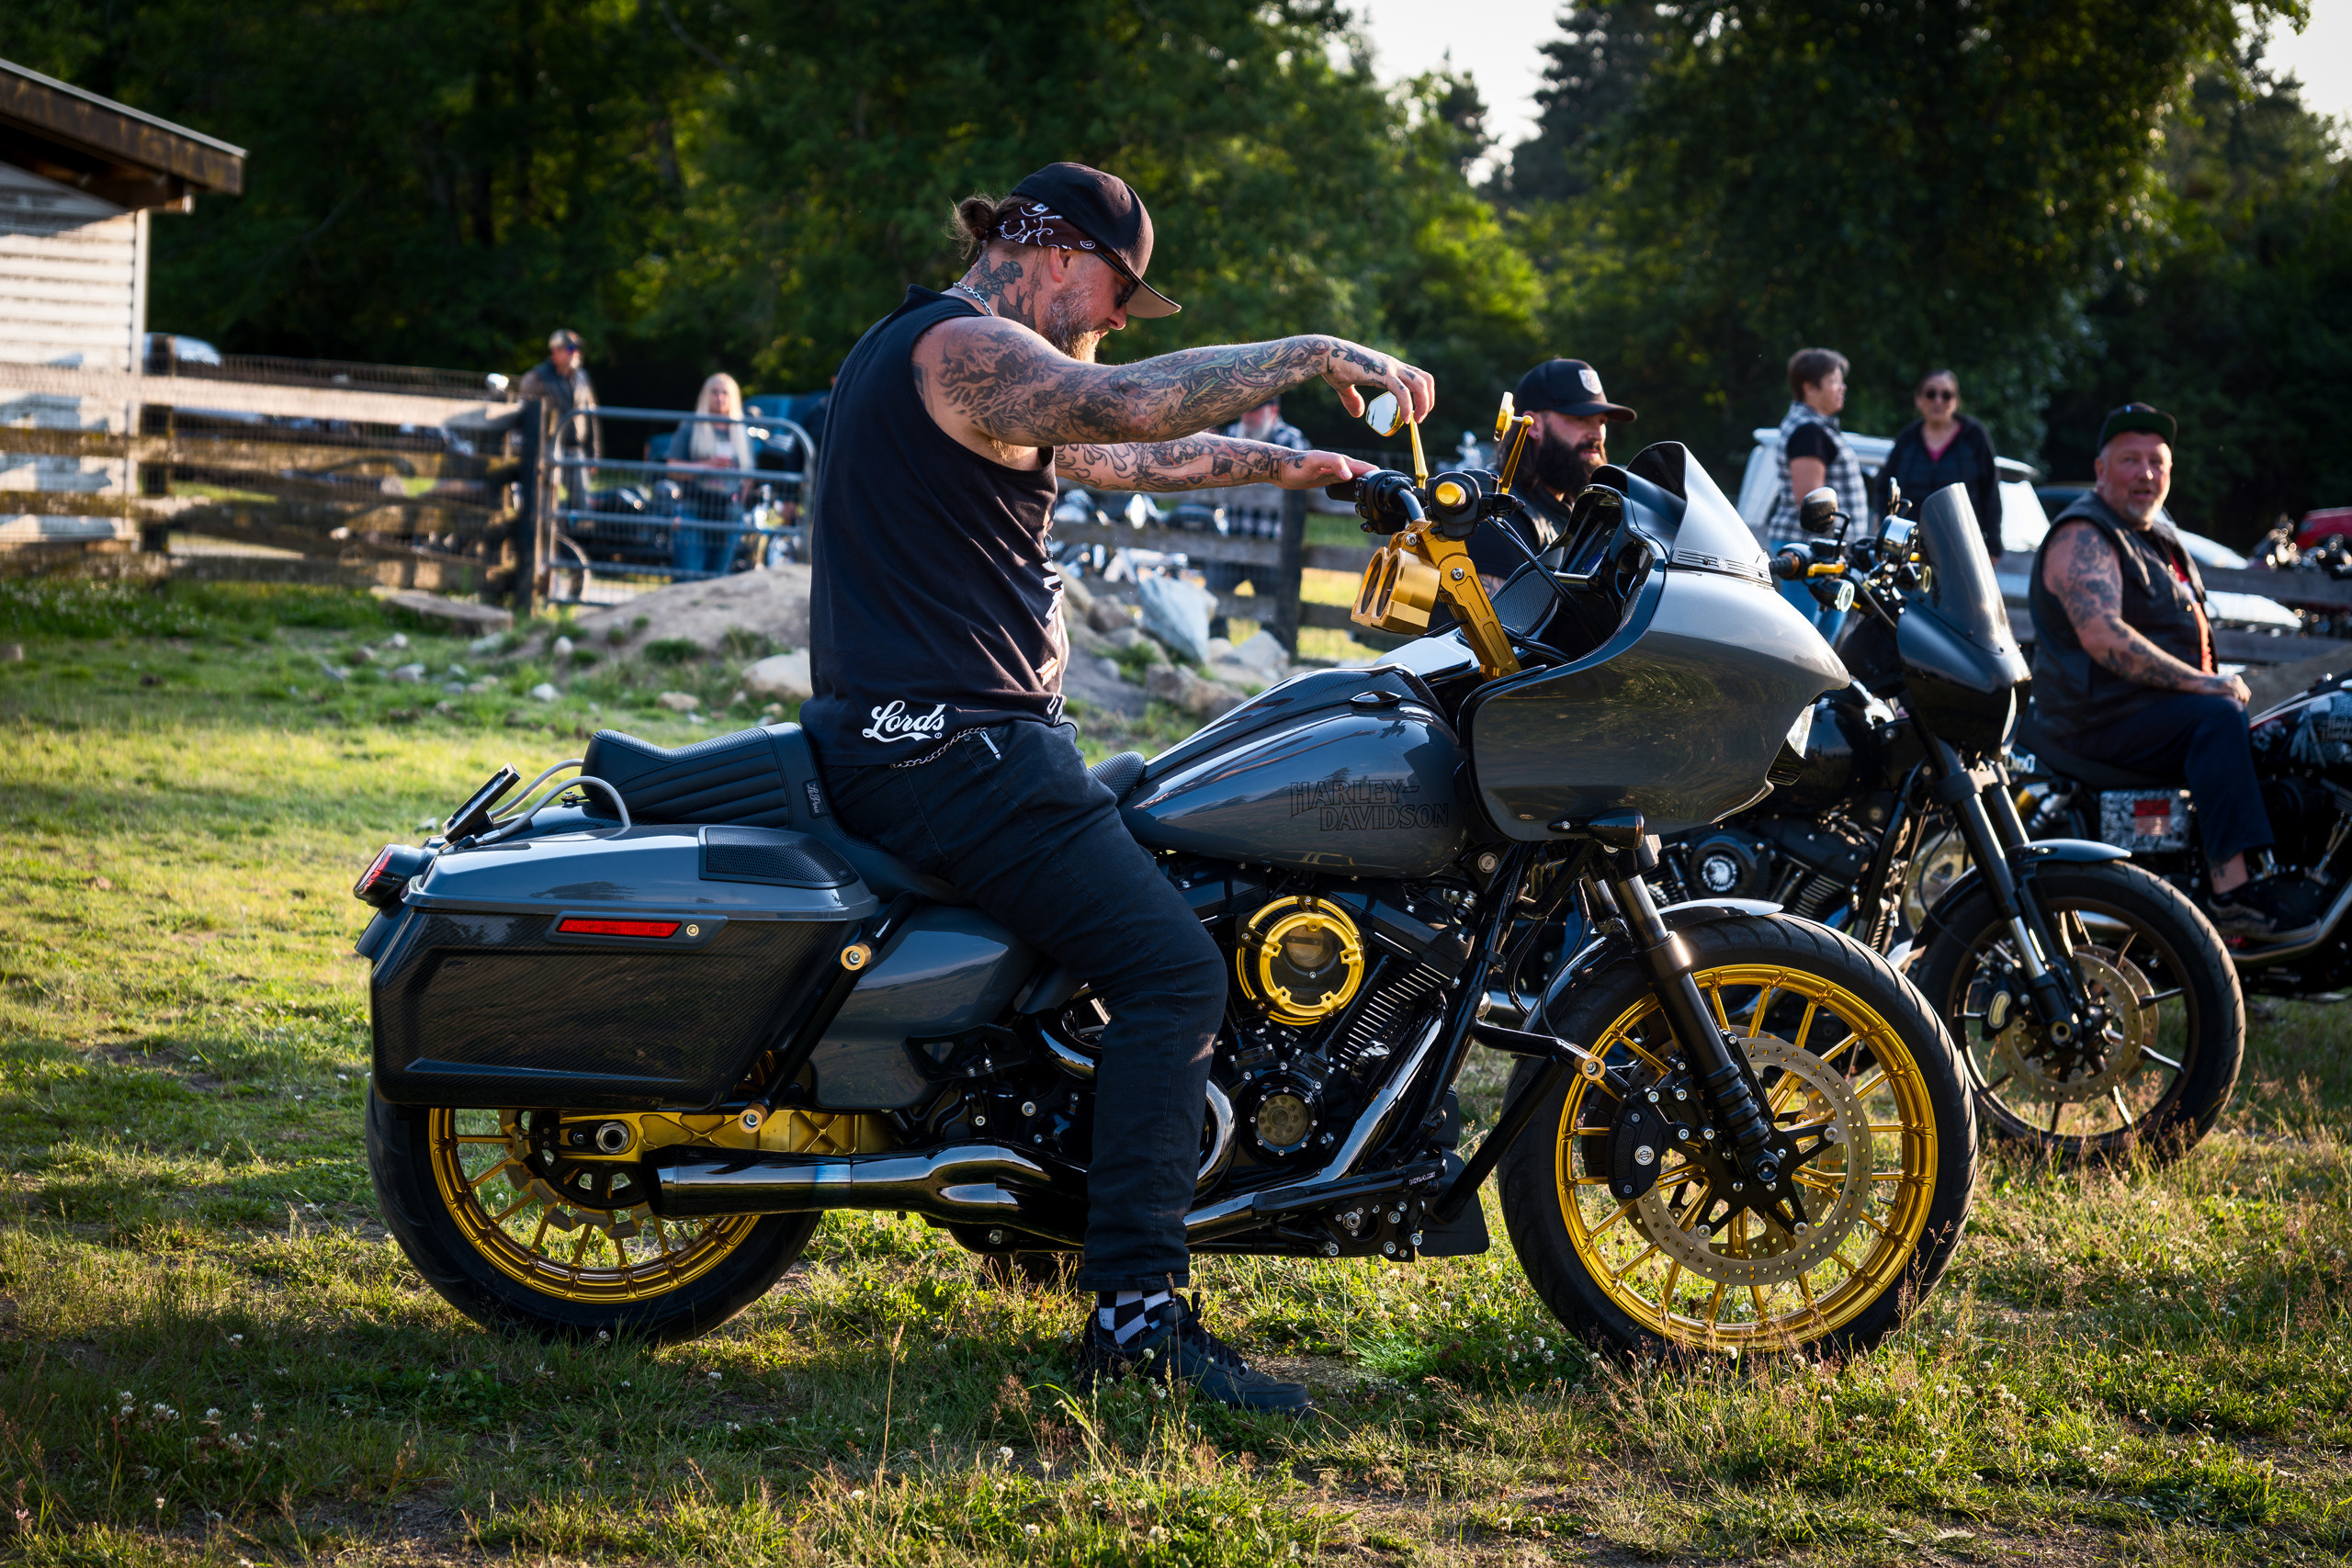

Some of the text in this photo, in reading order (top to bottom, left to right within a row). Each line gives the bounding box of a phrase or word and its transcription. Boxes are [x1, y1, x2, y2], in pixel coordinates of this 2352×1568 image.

[862, 700, 946, 742] Lords
[1291, 780, 1420, 817] HARLEY-
[1321, 804, 1449, 830] DAVIDSON
